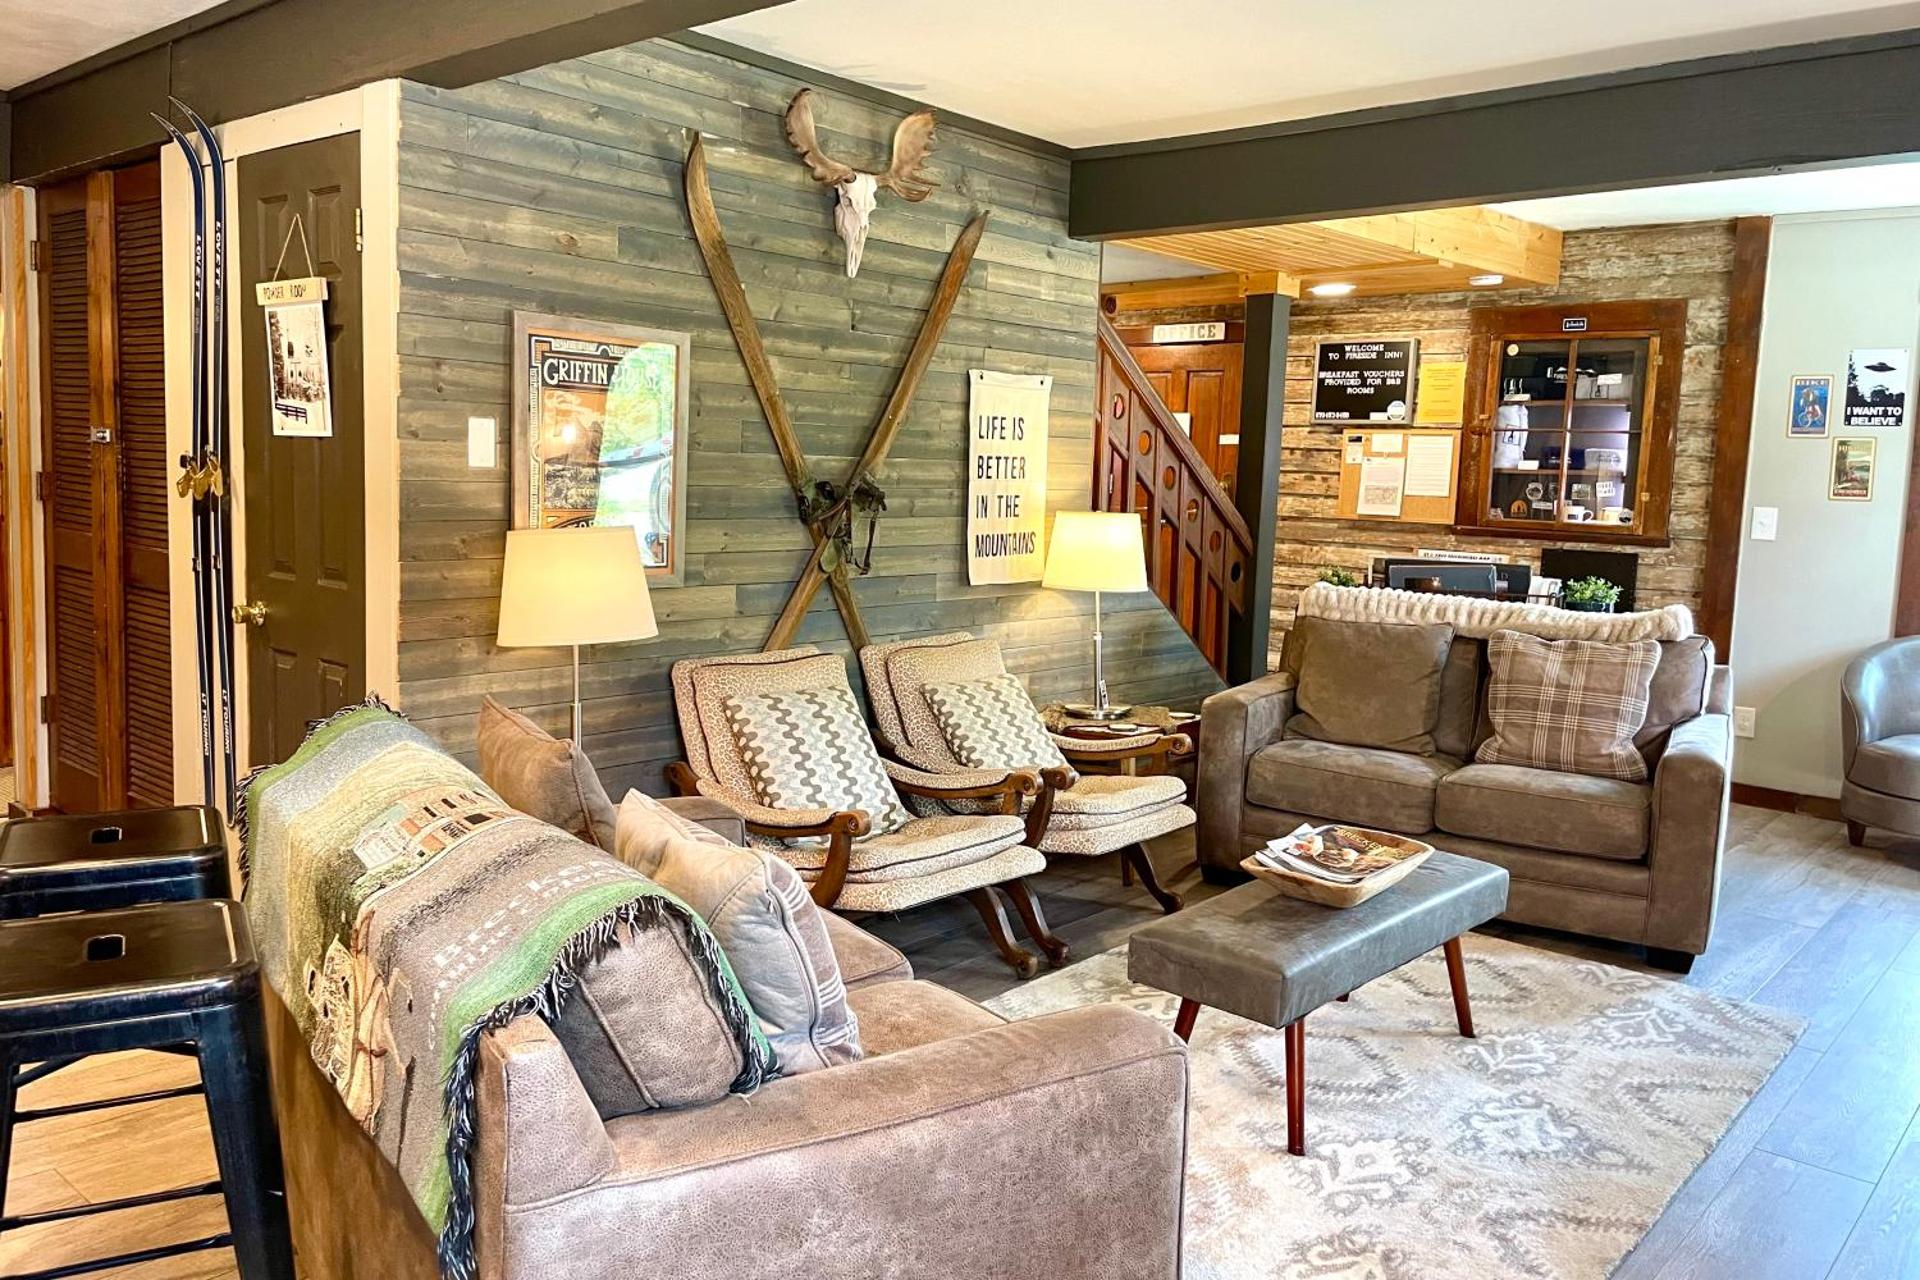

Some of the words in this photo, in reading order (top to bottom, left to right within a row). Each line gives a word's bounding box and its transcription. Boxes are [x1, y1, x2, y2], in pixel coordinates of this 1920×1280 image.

[1157, 324, 1217, 340] OFFICE
[1344, 344, 1385, 352] WELCOME
[1328, 352, 1340, 360] TO
[1345, 351, 1377, 360] FIRESIDE
[543, 358, 609, 385] GRIFFIN
[1319, 370, 1360, 379] BREAKFAST
[1362, 370, 1405, 378] VOUCHERS
[1324, 378, 1362, 386] PROVIDED
[1366, 378, 1382, 386] FOR
[1346, 387, 1375, 395] ROOMS
[1846, 406, 1851, 416] I
[1852, 406, 1885, 416] WANT
[1886, 406, 1902, 416] TO
[1850, 416, 1897, 426] BELIEVE
[978, 415, 1007, 440] LIFE
[1012, 416, 1025, 441] IS
[977, 455, 1026, 480] BETTER
[976, 494, 988, 519] IN
[997, 494, 1020, 518] THE
[974, 531, 1037, 558] MOUNTAINS
